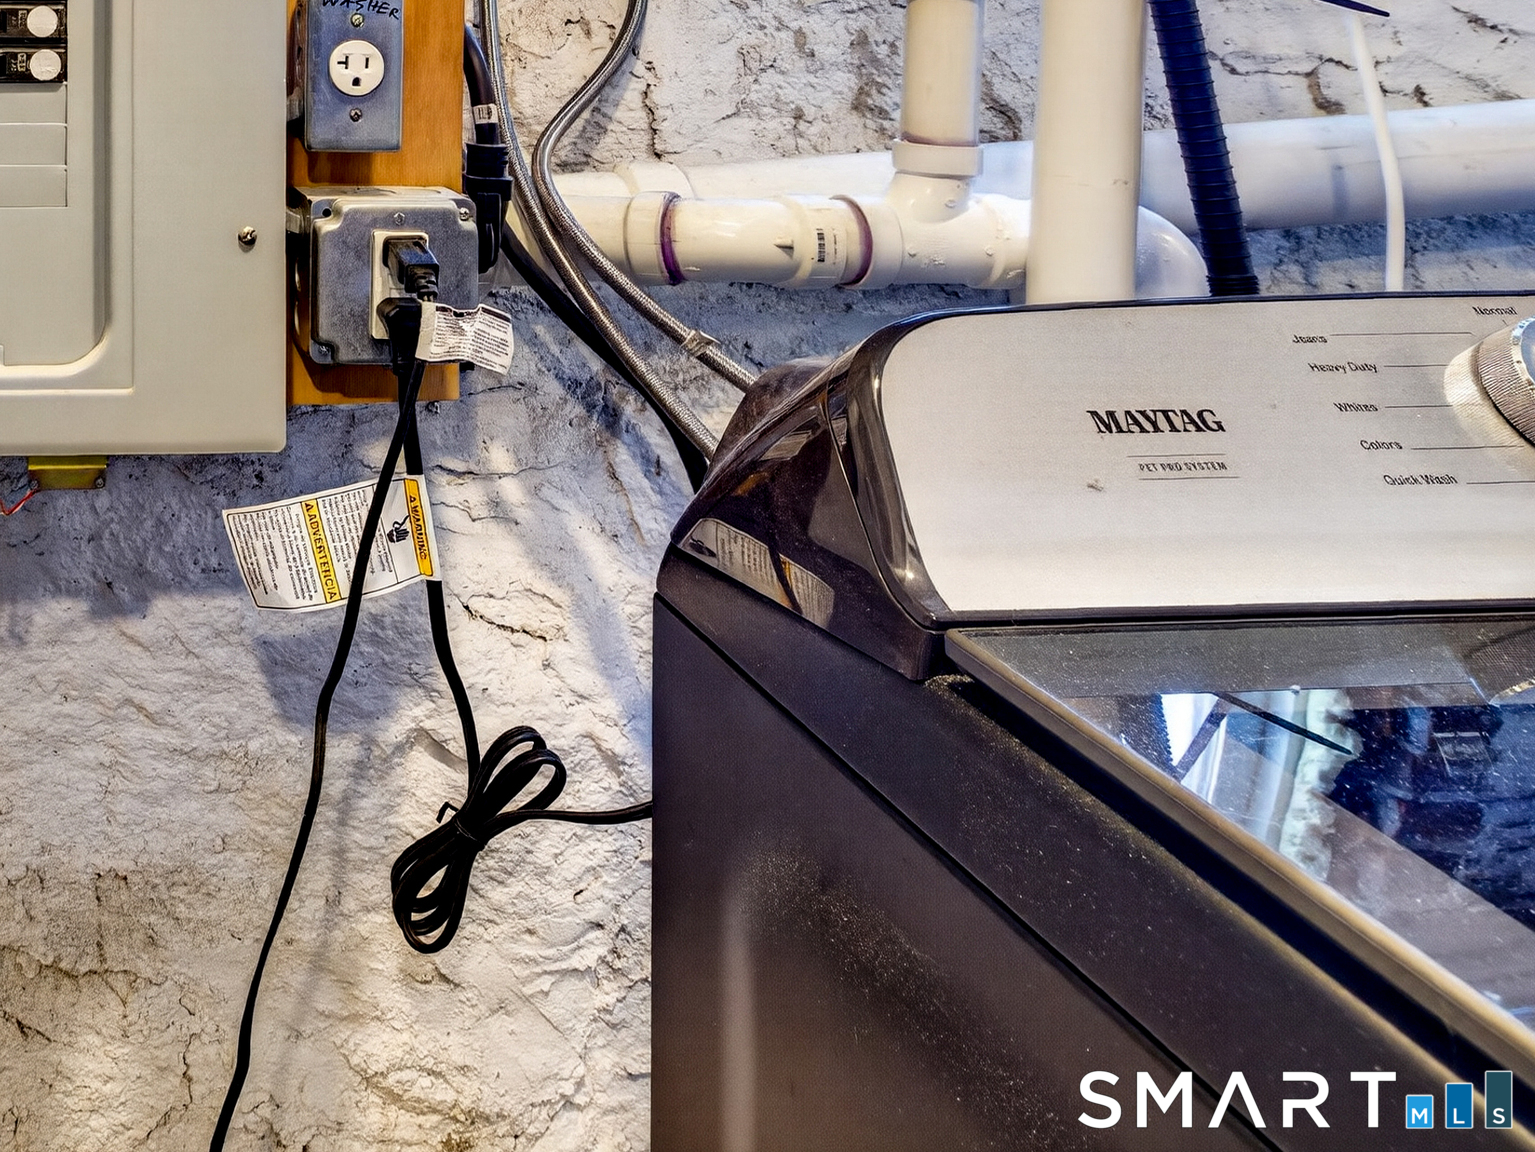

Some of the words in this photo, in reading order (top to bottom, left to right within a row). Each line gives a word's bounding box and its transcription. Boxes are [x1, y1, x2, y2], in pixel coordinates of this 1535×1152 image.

[1472, 306, 1517, 316] Normal
[1292, 334, 1328, 344] Jeans
[1309, 362, 1346, 374] Heavy
[1348, 362, 1378, 374] Duty
[1333, 402, 1378, 412] Whites
[1086, 409, 1226, 434] MAYTAG
[1360, 440, 1403, 450] Colors
[1138, 462, 1159, 472] PET
[1185, 461, 1228, 472] SYSTEM
[1383, 474, 1420, 486] Quick
[1422, 474, 1458, 485] Wash
